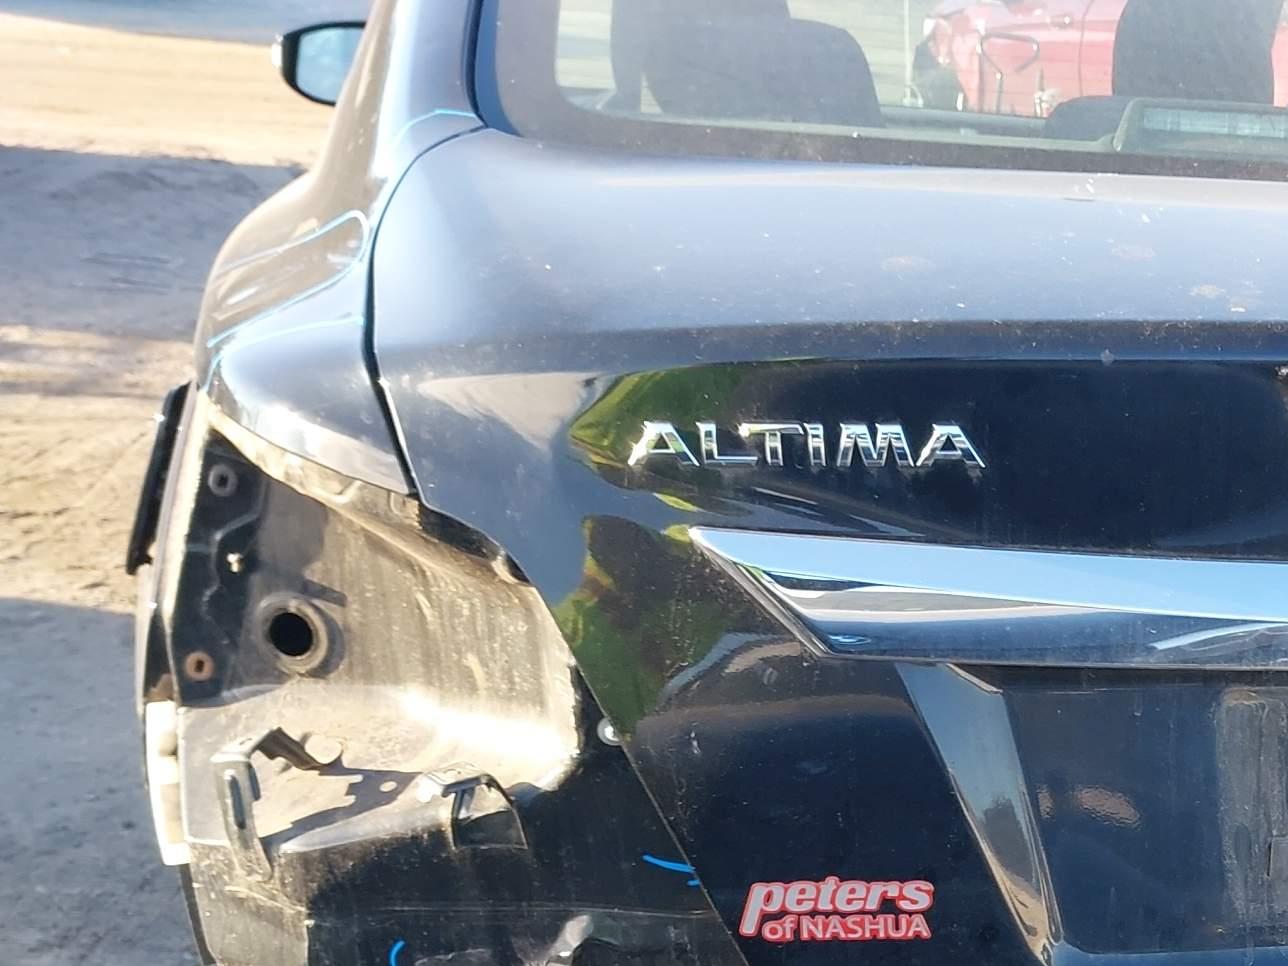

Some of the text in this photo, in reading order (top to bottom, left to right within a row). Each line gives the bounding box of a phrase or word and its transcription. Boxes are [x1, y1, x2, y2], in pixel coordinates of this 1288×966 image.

[627, 421, 986, 468] ALTIMA
[740, 877, 934, 936] peters
[763, 914, 931, 940] of NASHUA
